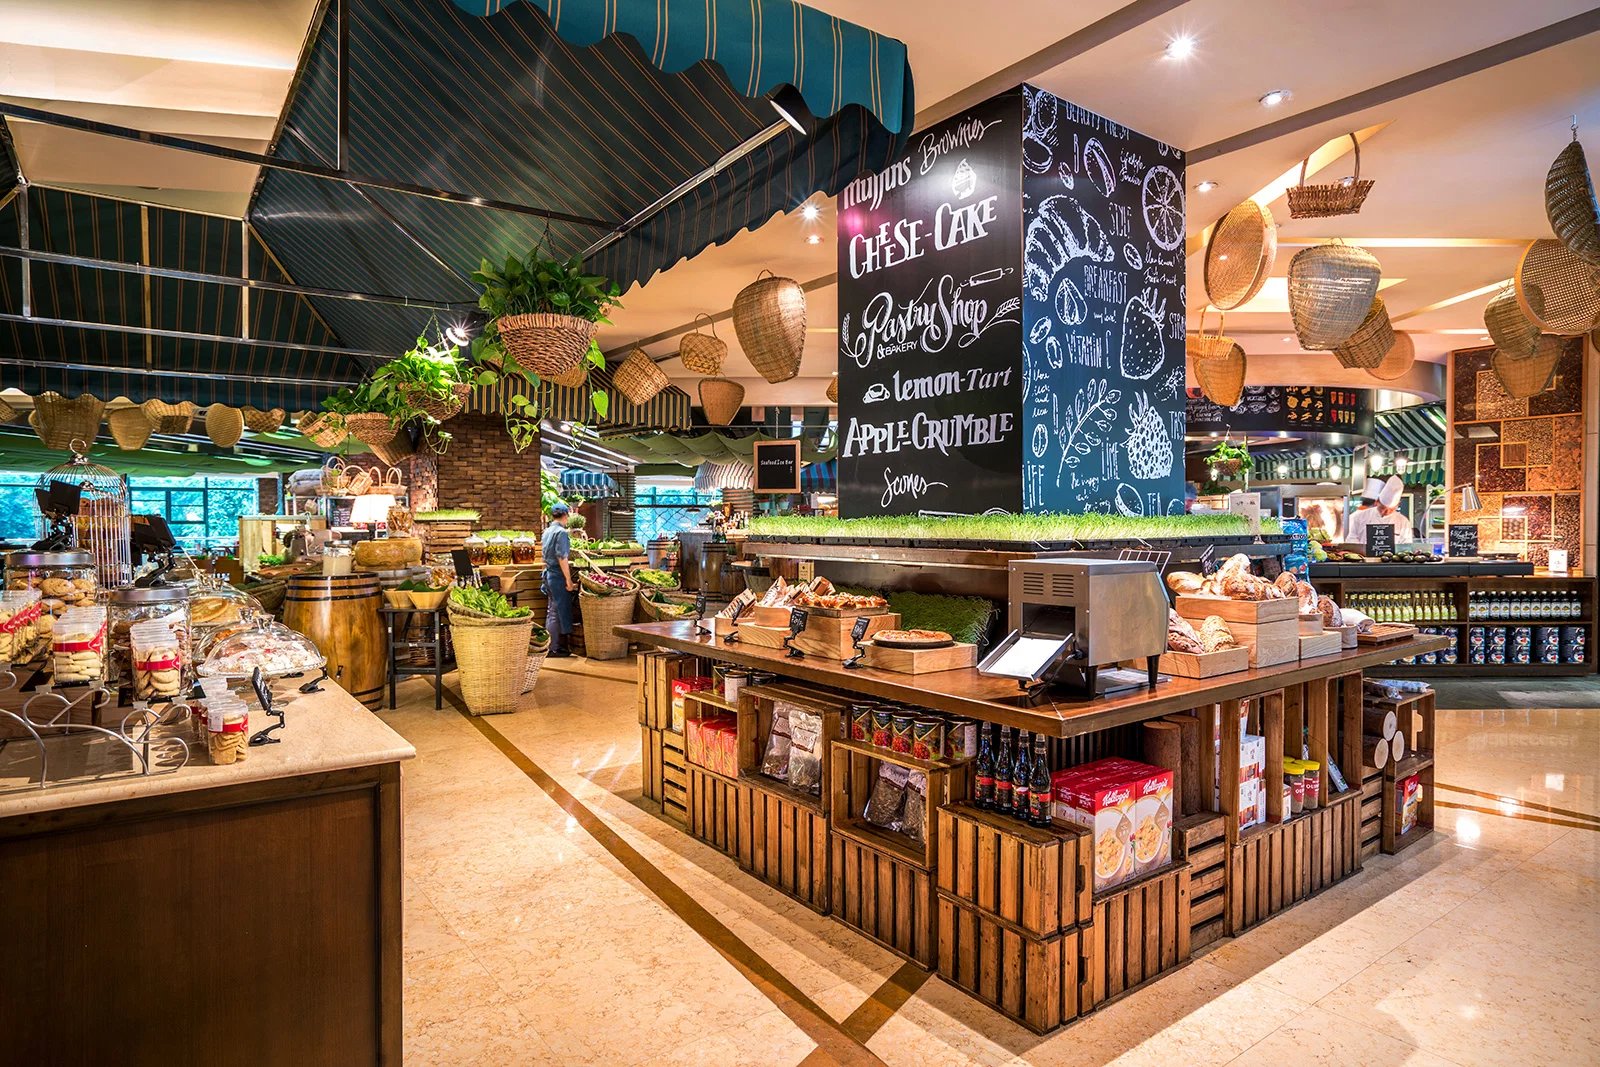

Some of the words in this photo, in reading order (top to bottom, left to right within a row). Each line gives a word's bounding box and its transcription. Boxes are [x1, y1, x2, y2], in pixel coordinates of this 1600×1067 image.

[918, 116, 1003, 176] Brownies
[1109, 202, 1132, 239] STYLE
[1083, 265, 1129, 304] BREAKFAST
[855, 278, 942, 368] Pastry
[920, 274, 988, 353] Shop
[1106, 330, 1113, 369] C
[881, 467, 948, 508] Scones
[1102, 789, 1130, 807] Kellogg's
